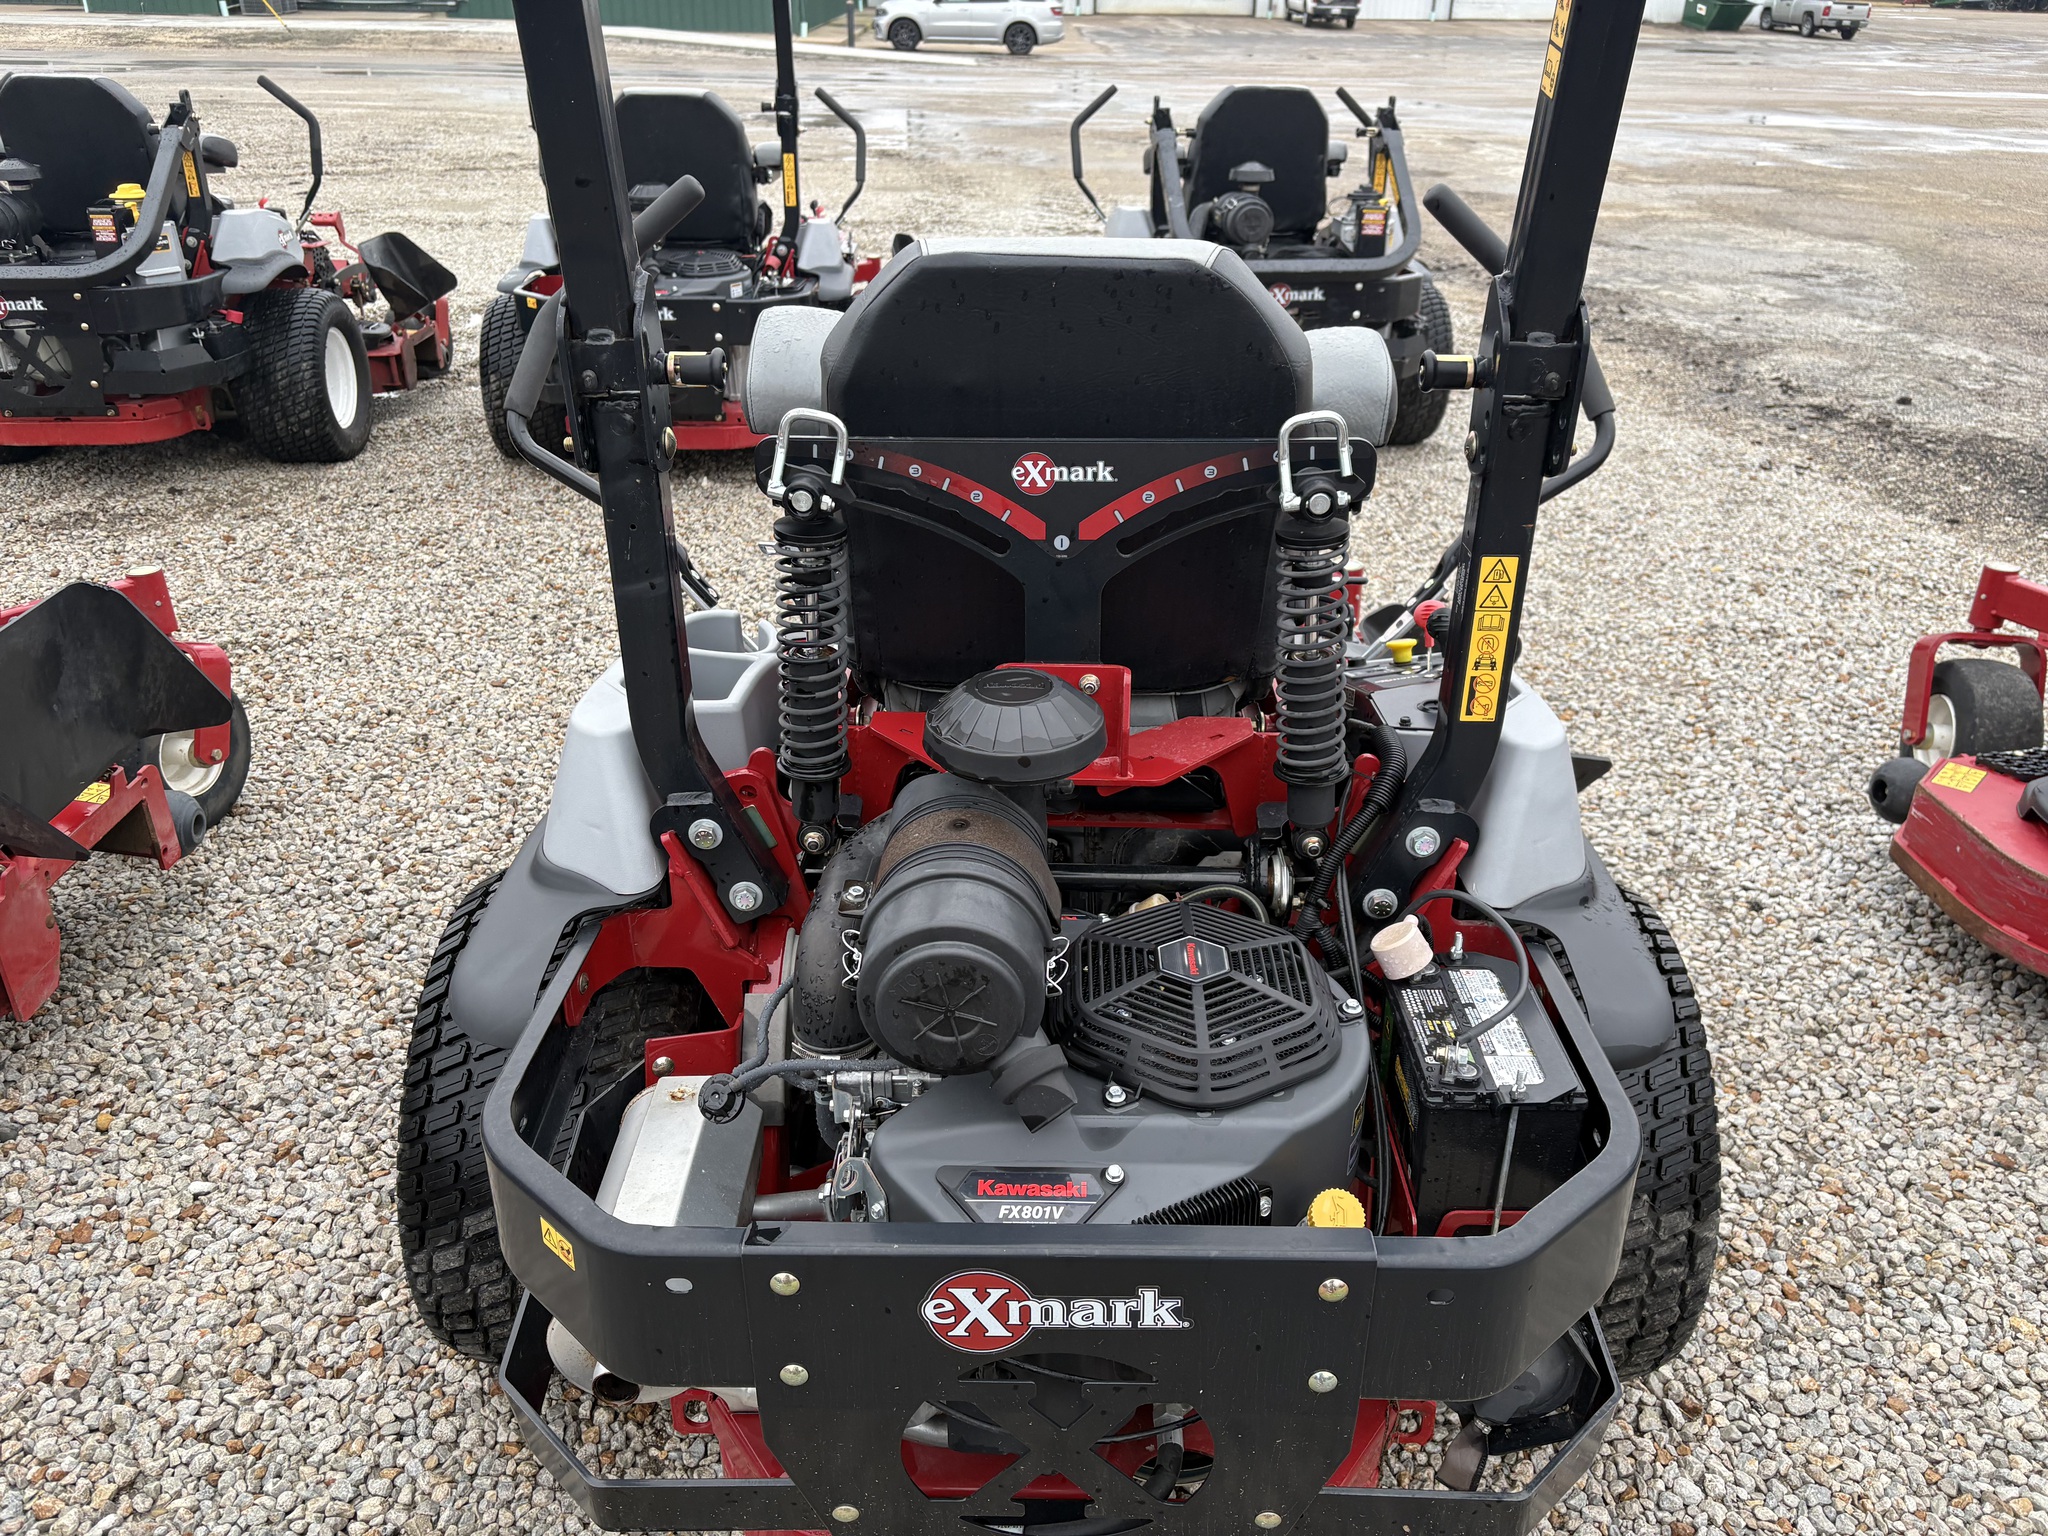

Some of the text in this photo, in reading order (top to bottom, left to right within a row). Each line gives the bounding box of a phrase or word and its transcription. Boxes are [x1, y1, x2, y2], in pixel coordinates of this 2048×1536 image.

[0, 297, 47, 314] mark
[1011, 460, 1118, 487] eXmark
[976, 1178, 1088, 1198] Kawasaki
[998, 1205, 1065, 1219] FX801V
[923, 1287, 1190, 1338] eXmark
